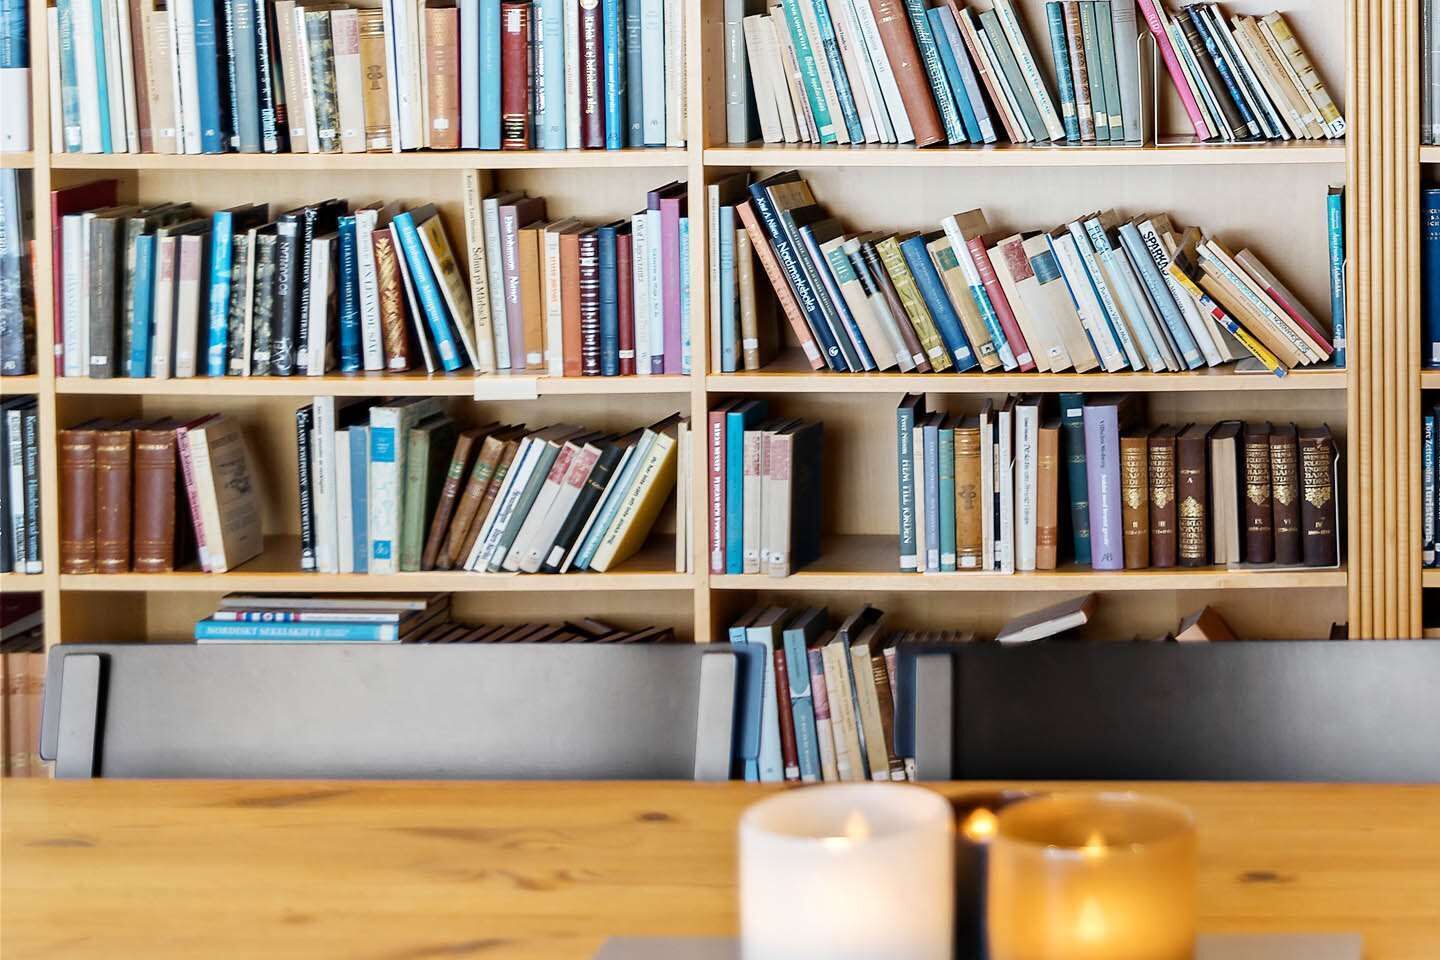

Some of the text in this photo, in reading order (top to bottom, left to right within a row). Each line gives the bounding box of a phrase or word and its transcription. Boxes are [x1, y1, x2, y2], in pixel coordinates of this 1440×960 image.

[584, 16, 594, 40] Kärlek
[472, 246, 487, 327] Selma på Mårbacka
[776, 242, 817, 312] Nordmarksboka
[1424, 422, 1434, 438] Tore
[902, 459, 911, 482] HEM
[1425, 439, 1434, 482] Zetterholm
[902, 485, 912, 504] TILL
